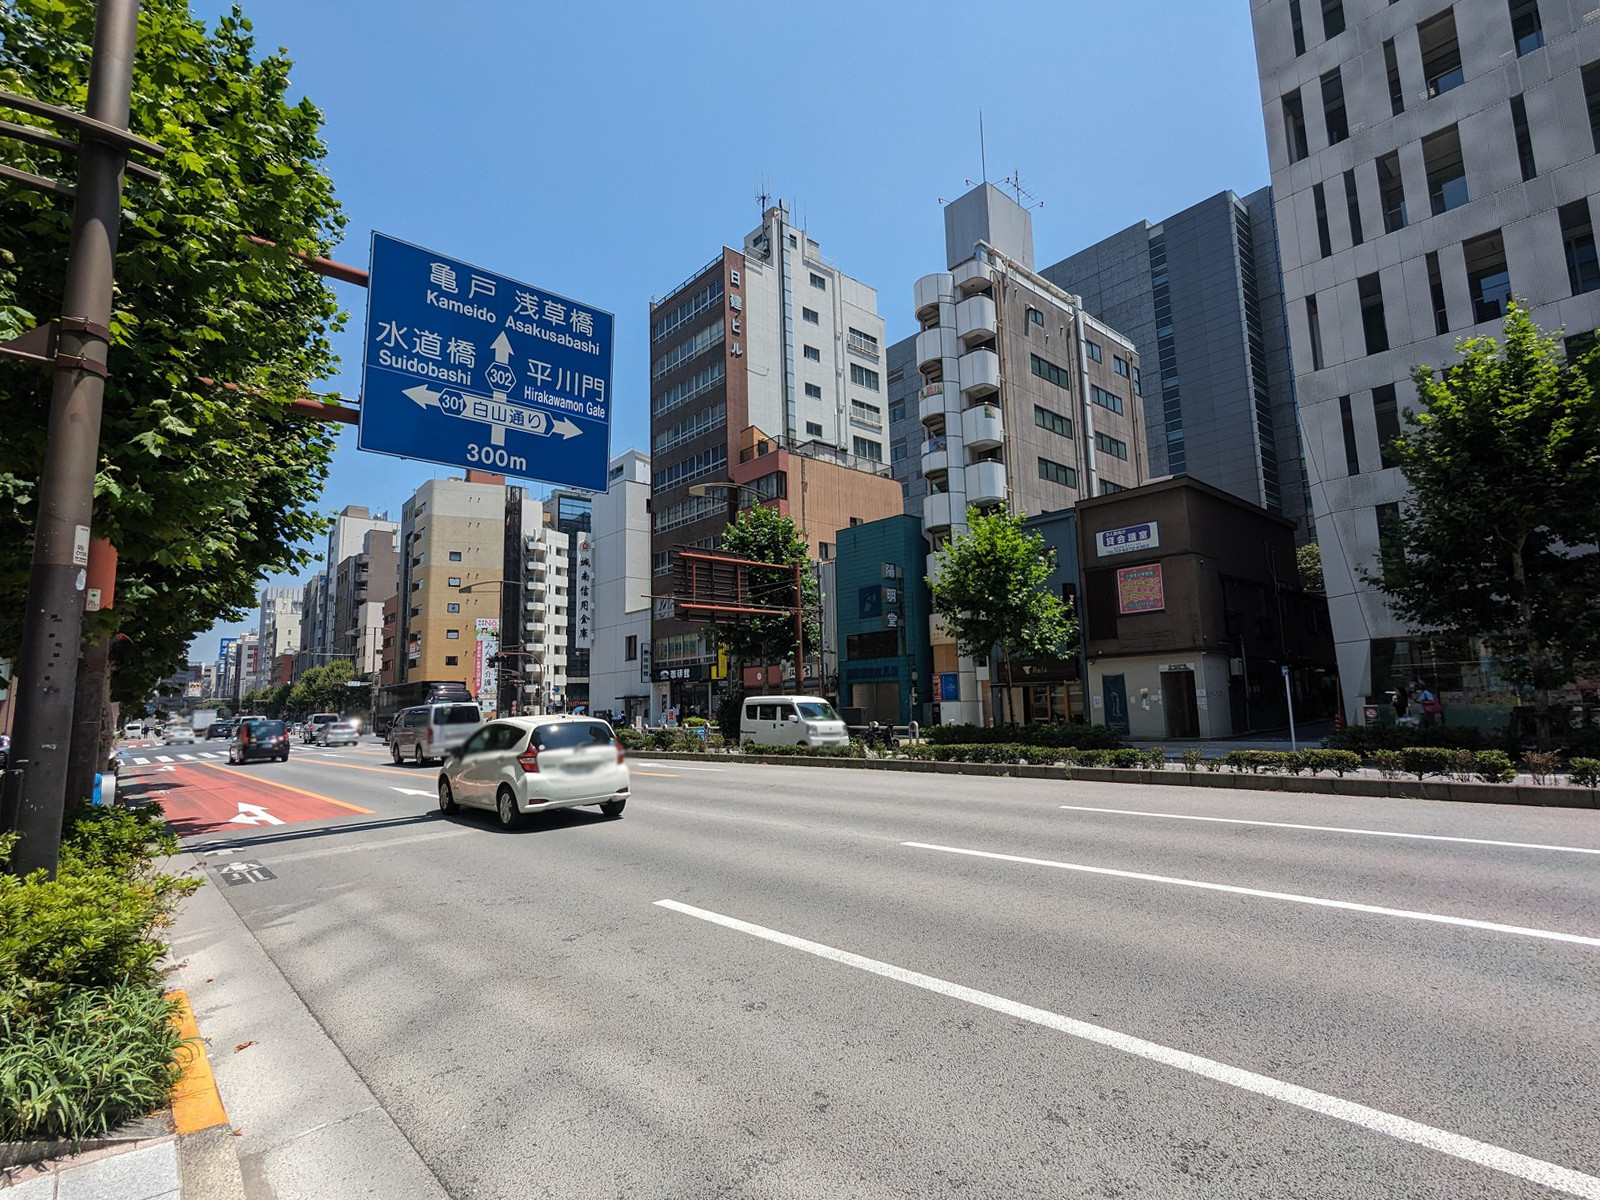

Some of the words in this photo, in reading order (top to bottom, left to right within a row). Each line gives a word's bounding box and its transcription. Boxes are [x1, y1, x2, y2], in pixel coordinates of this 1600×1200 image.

[429, 262, 497, 299] 亀戸
[426, 289, 497, 323] Kameido
[513, 289, 594, 338] 浅草橋
[375, 320, 477, 369] 水道橋
[504, 315, 600, 356] Asakusabashi
[379, 349, 472, 386] Suidobashi
[489, 368, 512, 387] 302
[526, 358, 605, 403] 平川門
[442, 394, 464, 412] 301
[473, 401, 541, 429] 白山通り
[524, 385, 584, 413] Hirakawamon
[586, 402, 606, 419] Gate
[466, 443, 527, 471] 300m
[579, 556, 591, 641] 城南信用金庫
[885, 563, 898, 628] 陽明堂
